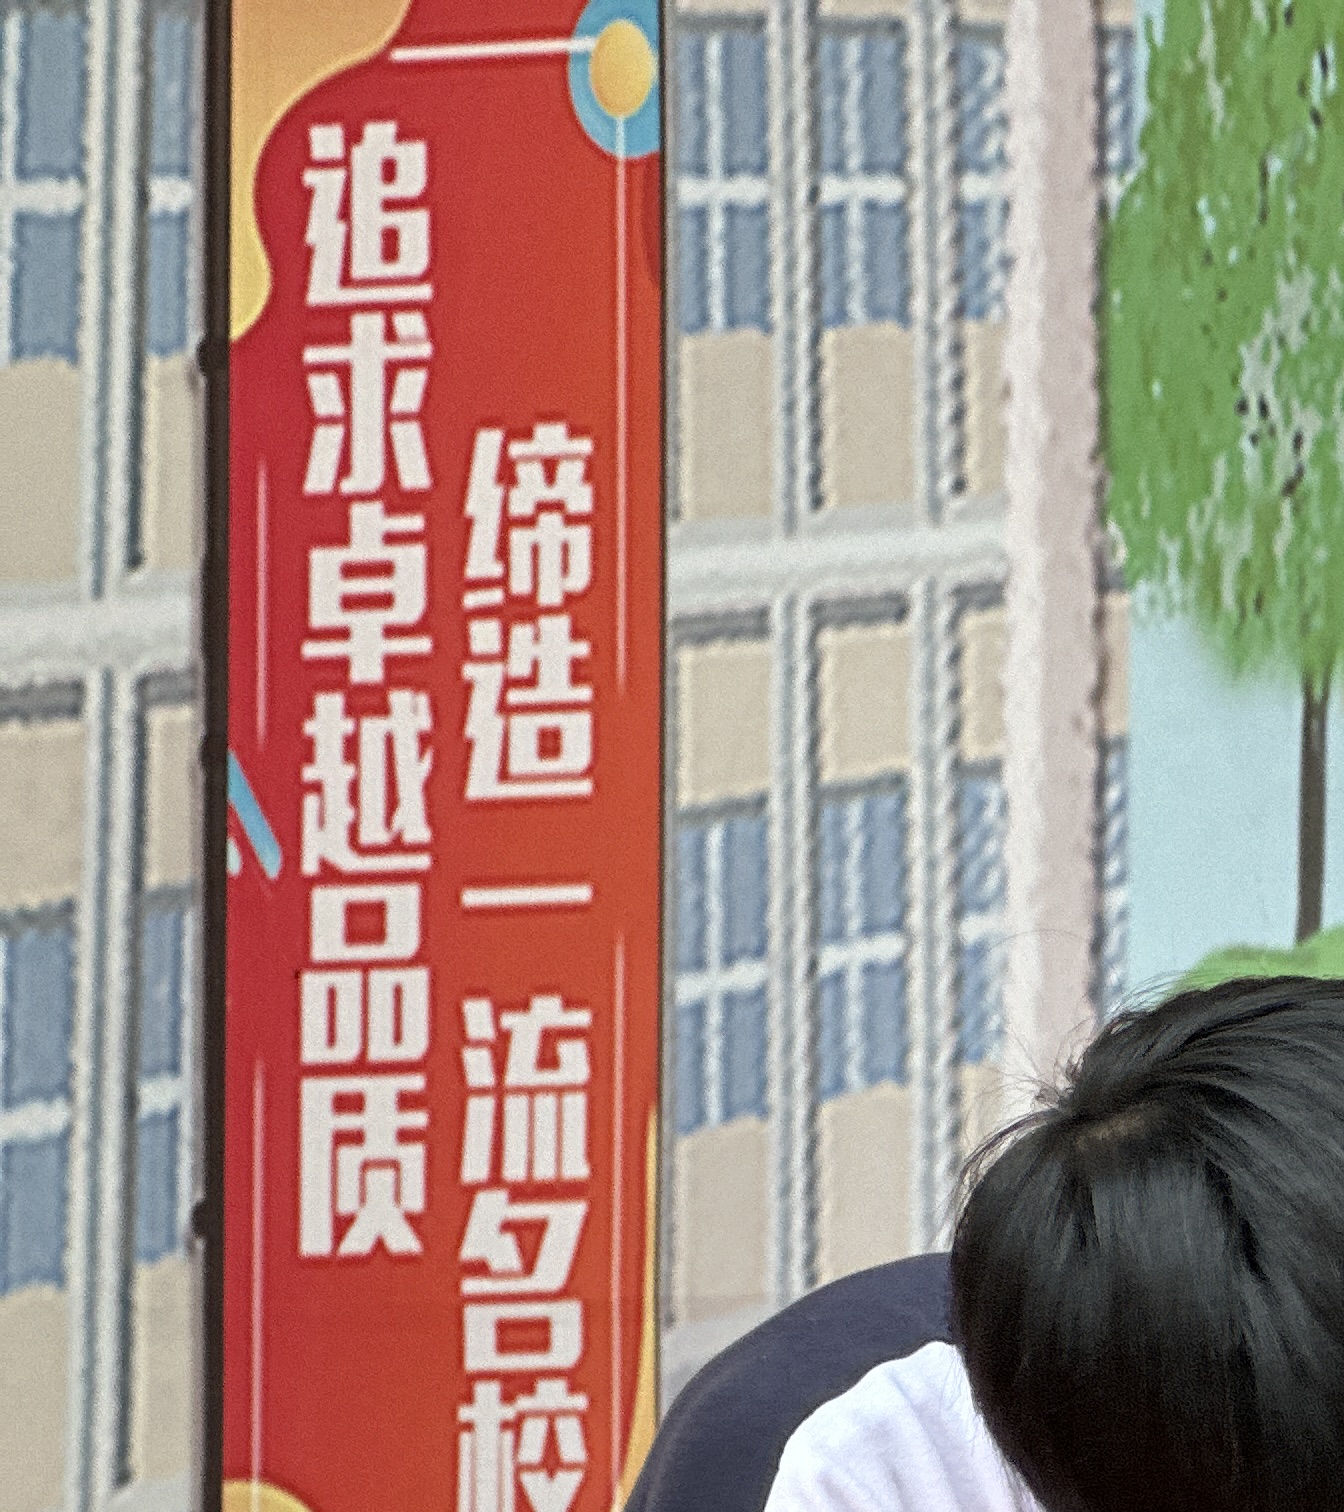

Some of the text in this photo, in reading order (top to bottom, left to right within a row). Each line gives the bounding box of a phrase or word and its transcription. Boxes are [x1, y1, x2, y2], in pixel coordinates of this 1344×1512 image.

[298, 119, 434, 1258] 追求卓越品质
